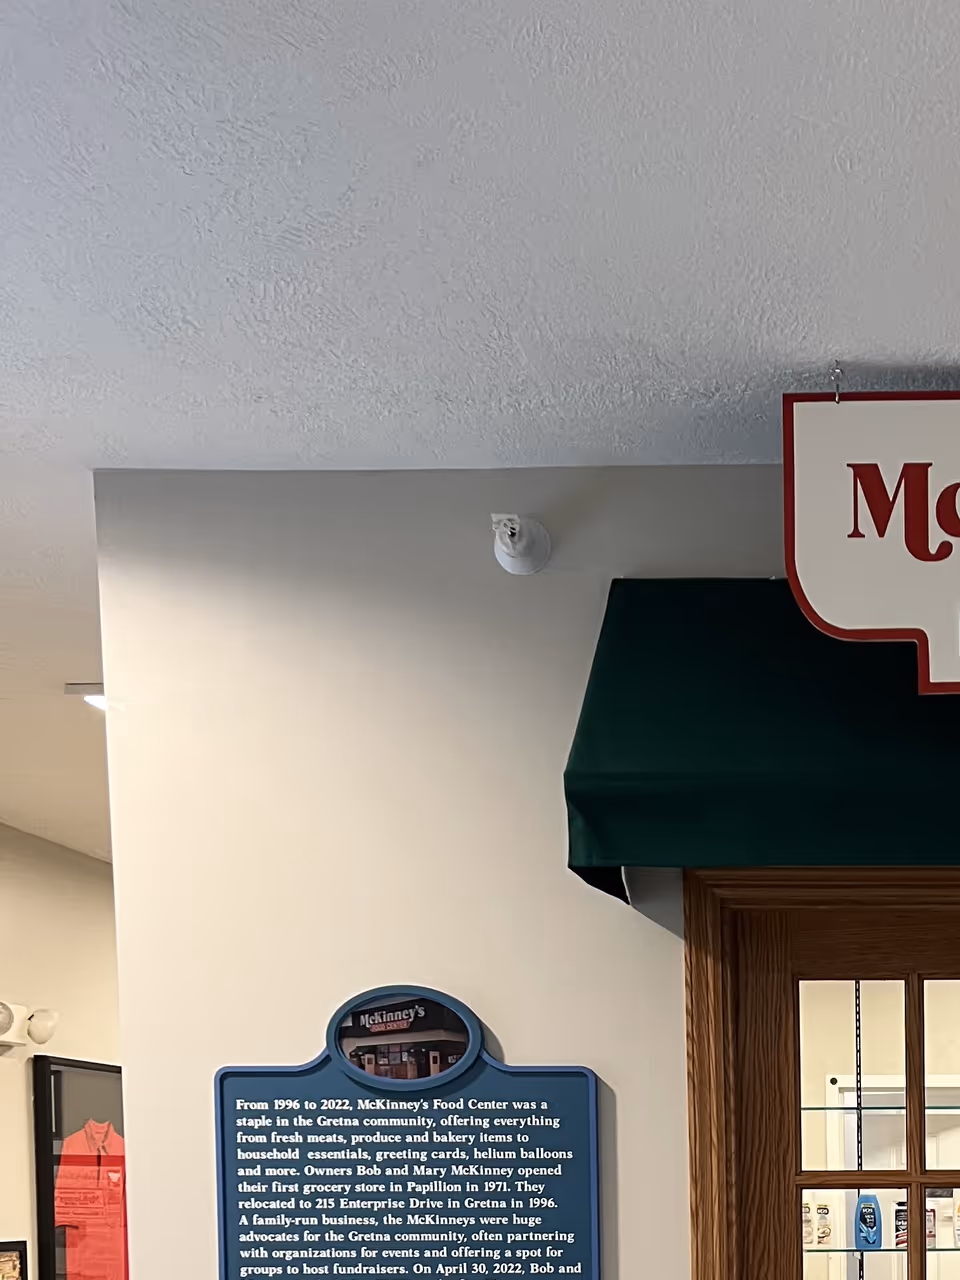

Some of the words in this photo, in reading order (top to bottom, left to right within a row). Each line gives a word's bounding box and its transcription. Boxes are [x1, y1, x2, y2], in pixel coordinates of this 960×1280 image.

[360, 1005, 426, 1028] McKinney's
[235, 1098, 270, 1111] From
[273, 1098, 301, 1111] 1996
[303, 1100, 318, 1110] to
[320, 1098, 354, 1112] 2022,
[356, 1098, 430, 1113] McKinney's
[432, 1097, 465, 1110] Food
[467, 1098, 509, 1110] Center
[511, 1101, 537, 1110] was
[540, 1101, 548, 1110] a
[235, 1114, 273, 1130] staple
[275, 1115, 290, 1127] in
[292, 1114, 314, 1127] the
[316, 1115, 360, 1127] Gretna
[362, 1115, 437, 1129] community,
[439, 1114, 491, 1129] offering
[493, 1114, 561, 1129] everything
[236, 1131, 268, 1144] from
[270, 1131, 304, 1144] fresh
[306, 1133, 348, 1145] meats,
[350, 1130, 402, 1146] produce
[405, 1130, 430, 1143] and
[432, 1130, 476, 1146] bakery
[479, 1131, 513, 1143] items
[516, 1133, 530, 1143] to
[236, 1147, 300, 1160] household
[306, 1147, 372, 1161] essentials,
[375, 1148, 428, 1163] greeting
[430, 1147, 470, 1161] cards,
[473, 1147, 517, 1159] helium
[519, 1147, 574, 1159] balloons
[236, 1164, 262, 1177] and
[264, 1167, 301, 1177] more.
[303, 1164, 353, 1176] Owners
[356, 1163, 382, 1176] Bob
[384, 1163, 409, 1176] and
[412, 1164, 448, 1179] Mary
[450, 1164, 514, 1179] McKinney
[517, 1163, 563, 1178] opened
[237, 1180, 269, 1193] their
[271, 1180, 300, 1193] first
[302, 1184, 352, 1196] grocery
[354, 1182, 386, 1193] store
[389, 1181, 403, 1193] in
[406, 1180, 462, 1195] Papillion
[465, 1181, 479, 1192] in
[483, 1181, 512, 1192] 1971.
[514, 1180, 546, 1195] They
[237, 1197, 296, 1210] relocated
[298, 1199, 313, 1210] to
[314, 1197, 336, 1209] 215
[339, 1197, 406, 1212] Enterprise
[409, 1197, 444, 1209] Drive
[447, 1197, 461, 1209] in
[464, 1197, 507, 1209] Gretna
[510, 1197, 524, 1209] in
[528, 1197, 558, 1209] 1996.
[238, 1214, 249, 1226] A
[252, 1213, 319, 1229] family-run
[321, 1213, 379, 1227] business,
[382, 1213, 403, 1225] the
[406, 1213, 476, 1228] McKinneys
[478, 1216, 509, 1225] were
[512, 1213, 542, 1228] huge
[238, 1230, 300, 1243] advocates
[303, 1229, 322, 1242] for
[324, 1229, 345, 1242] the
[347, 1230, 391, 1242] Gretna
[394, 1230, 468, 1244] community,
[471, 1229, 503, 1241] often
[506, 1230, 575, 1244] partnering
[239, 1246, 269, 1259] with
[271, 1247, 358, 1261] organizations
[360, 1246, 379, 1258] for
[381, 1248, 421, 1258] events
[423, 1246, 448, 1258] and
[450, 1245, 501, 1261] offering
[504, 1249, 512, 1258] a
[515, 1247, 542, 1260] spot
[545, 1245, 564, 1258] for
[239, 1266, 283, 1278] groups
[286, 1265, 300, 1275] to
[302, 1262, 330, 1275] host
[332, 1262, 409, 1275] fundraisers.
[412, 1263, 432, 1274] On
[435, 1262, 468, 1277] April
[471, 1262, 489, 1275] 30,
[492, 1262, 526, 1276] 2022,
[529, 1261, 555, 1274] Bob
[558, 1261, 582, 1274] and
